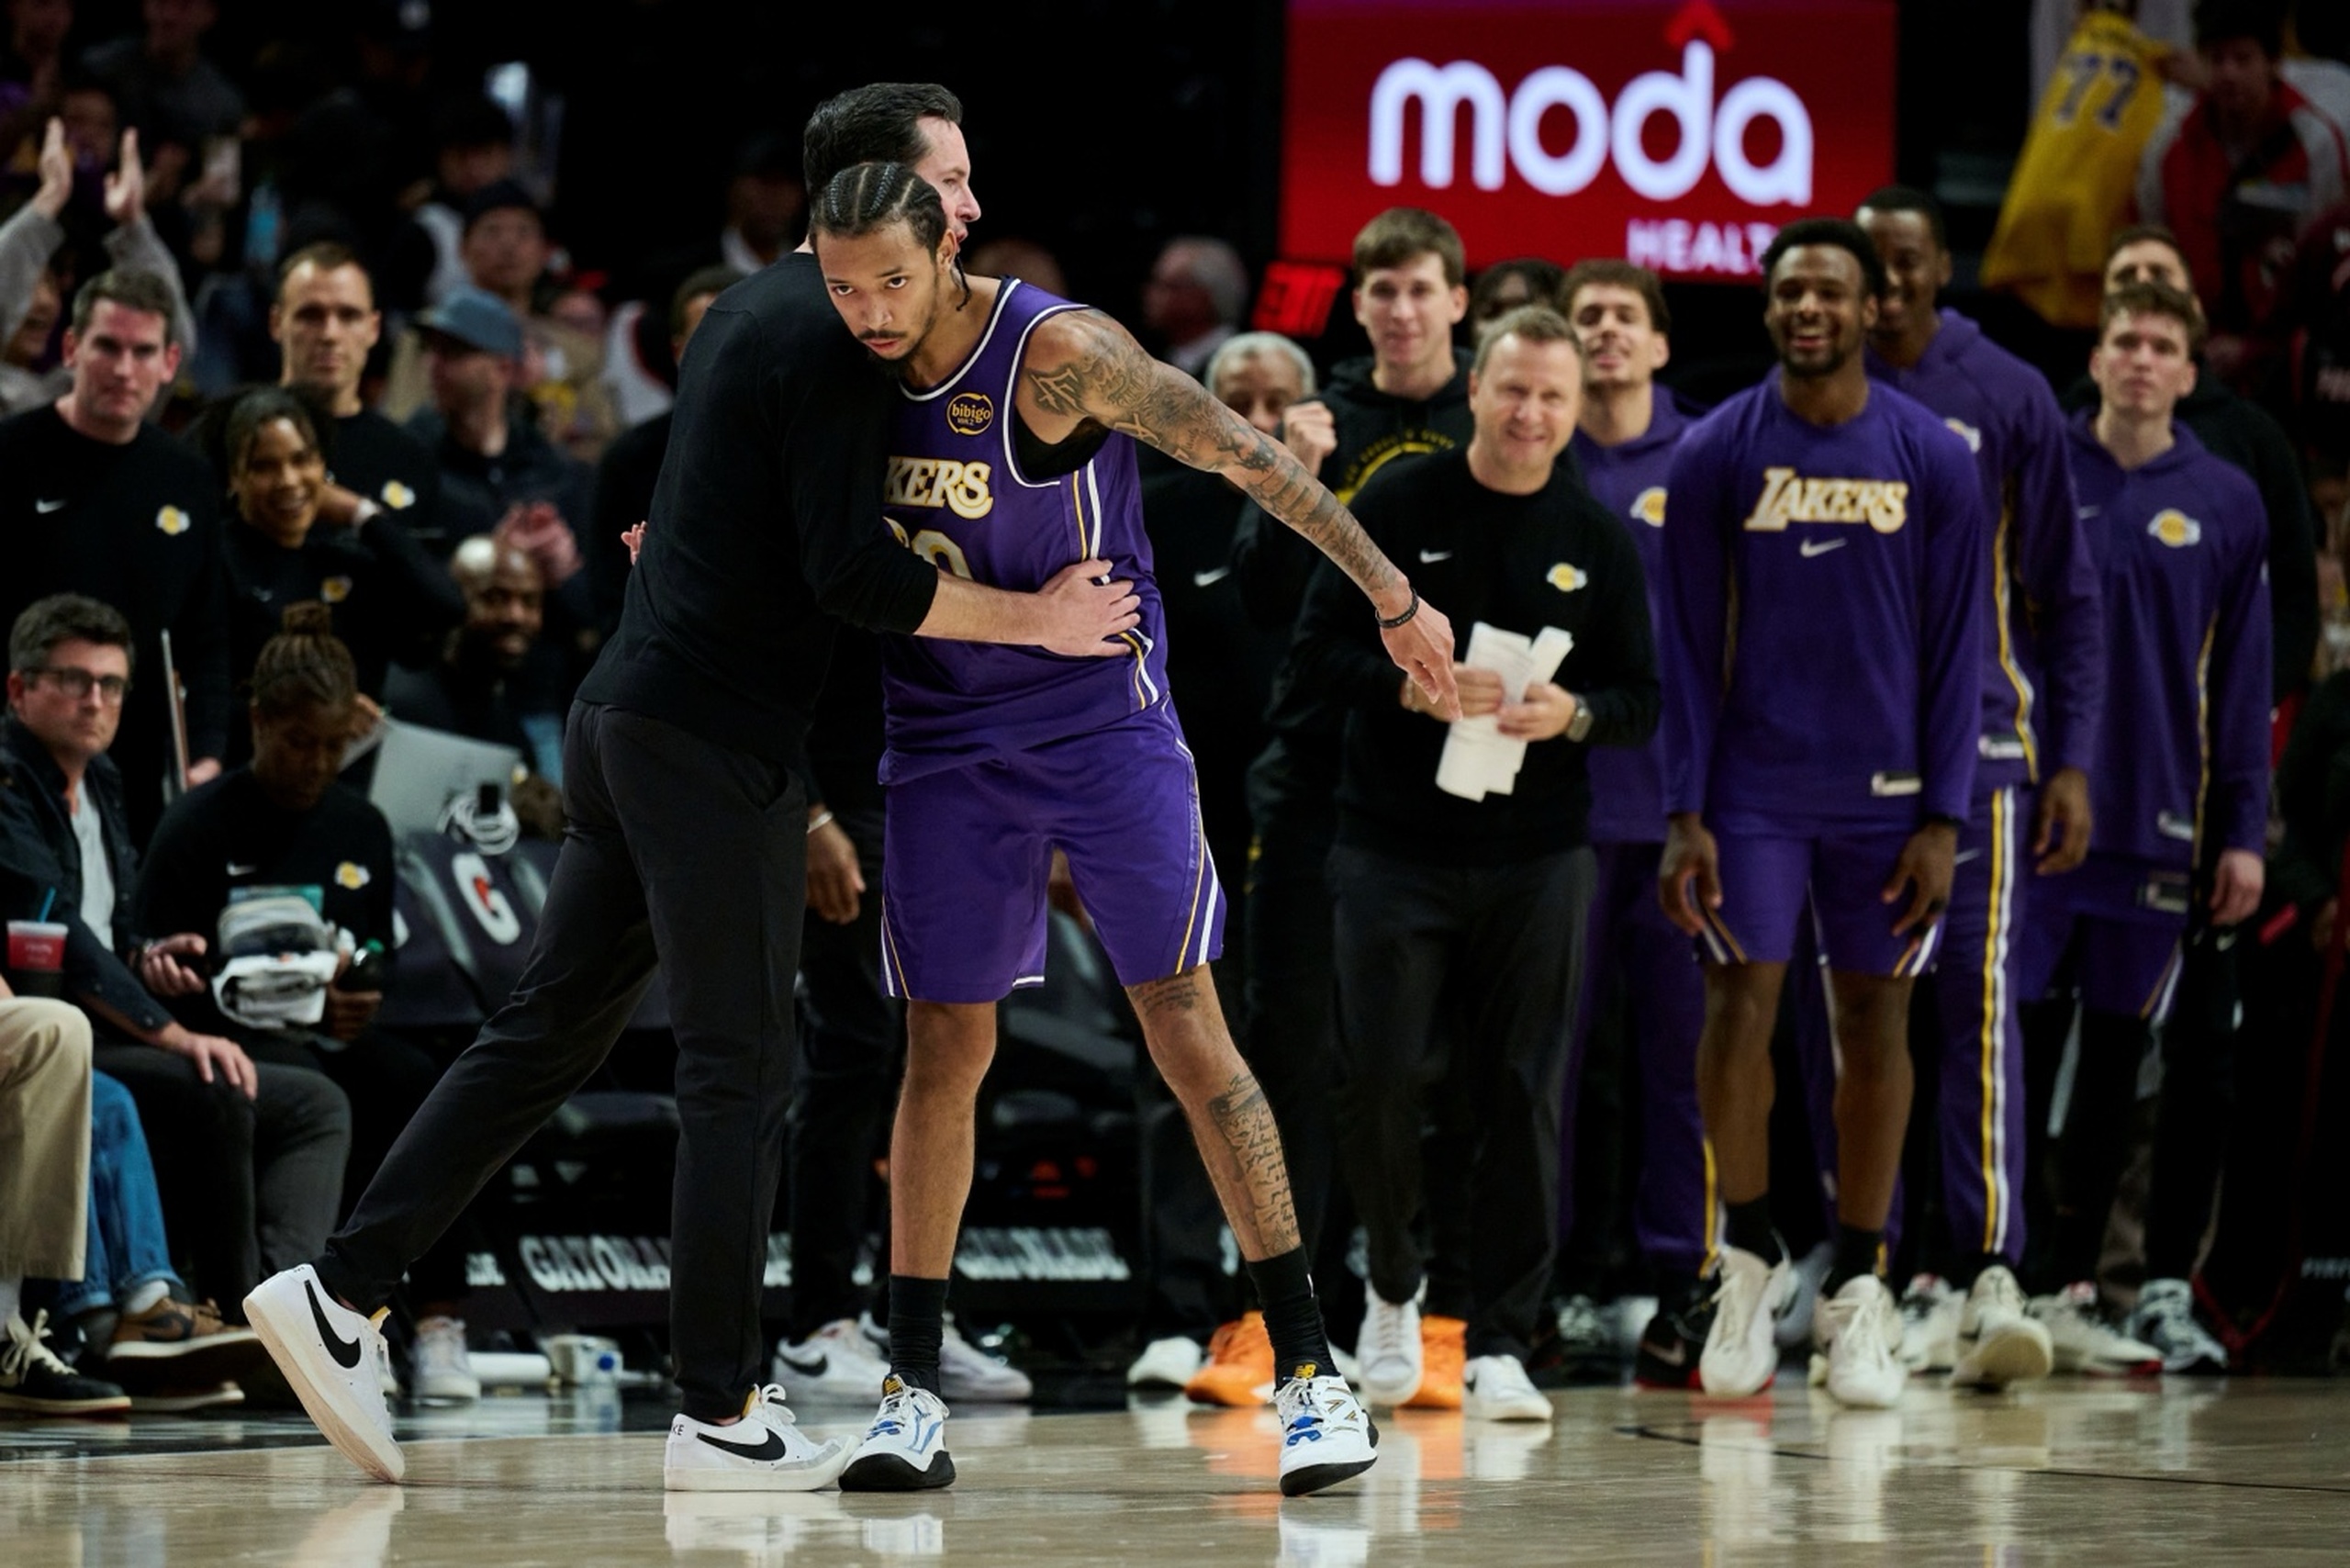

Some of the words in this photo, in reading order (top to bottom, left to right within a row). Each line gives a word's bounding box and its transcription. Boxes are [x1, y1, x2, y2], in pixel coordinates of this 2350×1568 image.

[1369, 39, 1814, 207] moda
[2054, 54, 2140, 129] 77
[952, 404, 991, 423] bibigo
[1742, 465, 1909, 534] LAKERS
